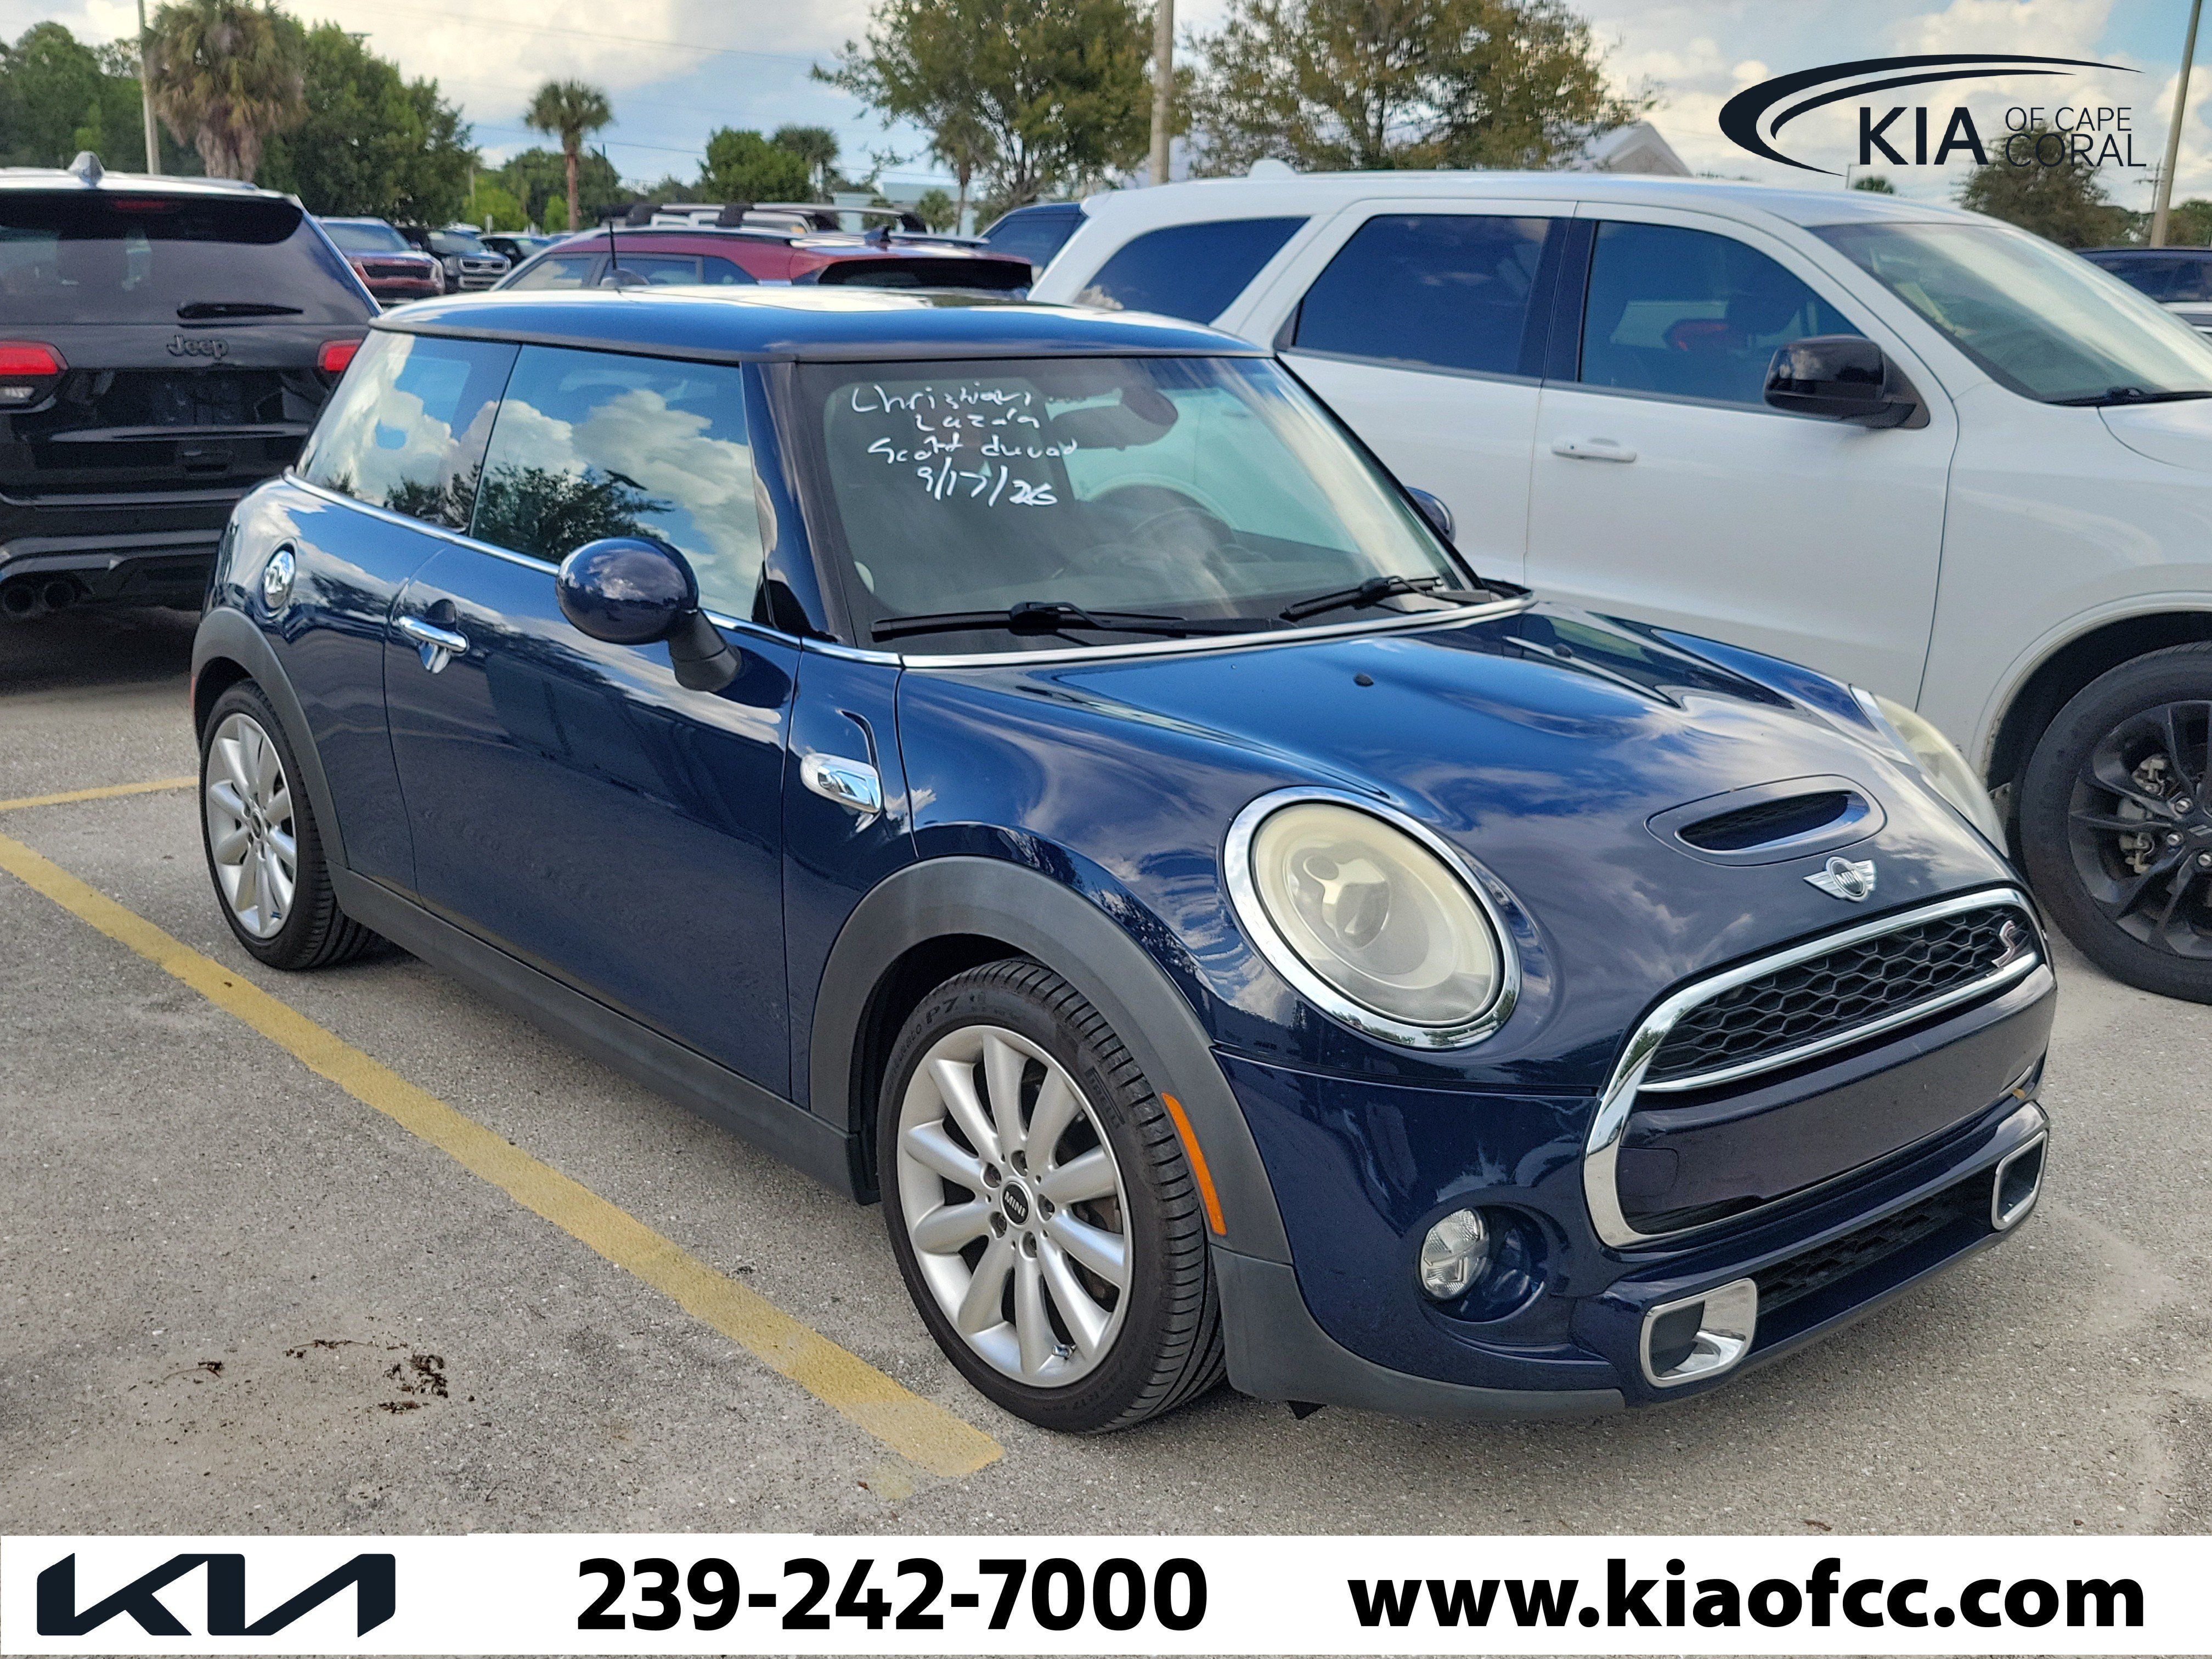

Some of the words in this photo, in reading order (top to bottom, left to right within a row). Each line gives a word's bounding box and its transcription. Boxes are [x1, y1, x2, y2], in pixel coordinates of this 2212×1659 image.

[166, 334, 229, 360] Jeep
[1991, 919, 2016, 968] S
[925, 995, 960, 1025] P7
[1004, 1190, 1026, 1217] MINI
